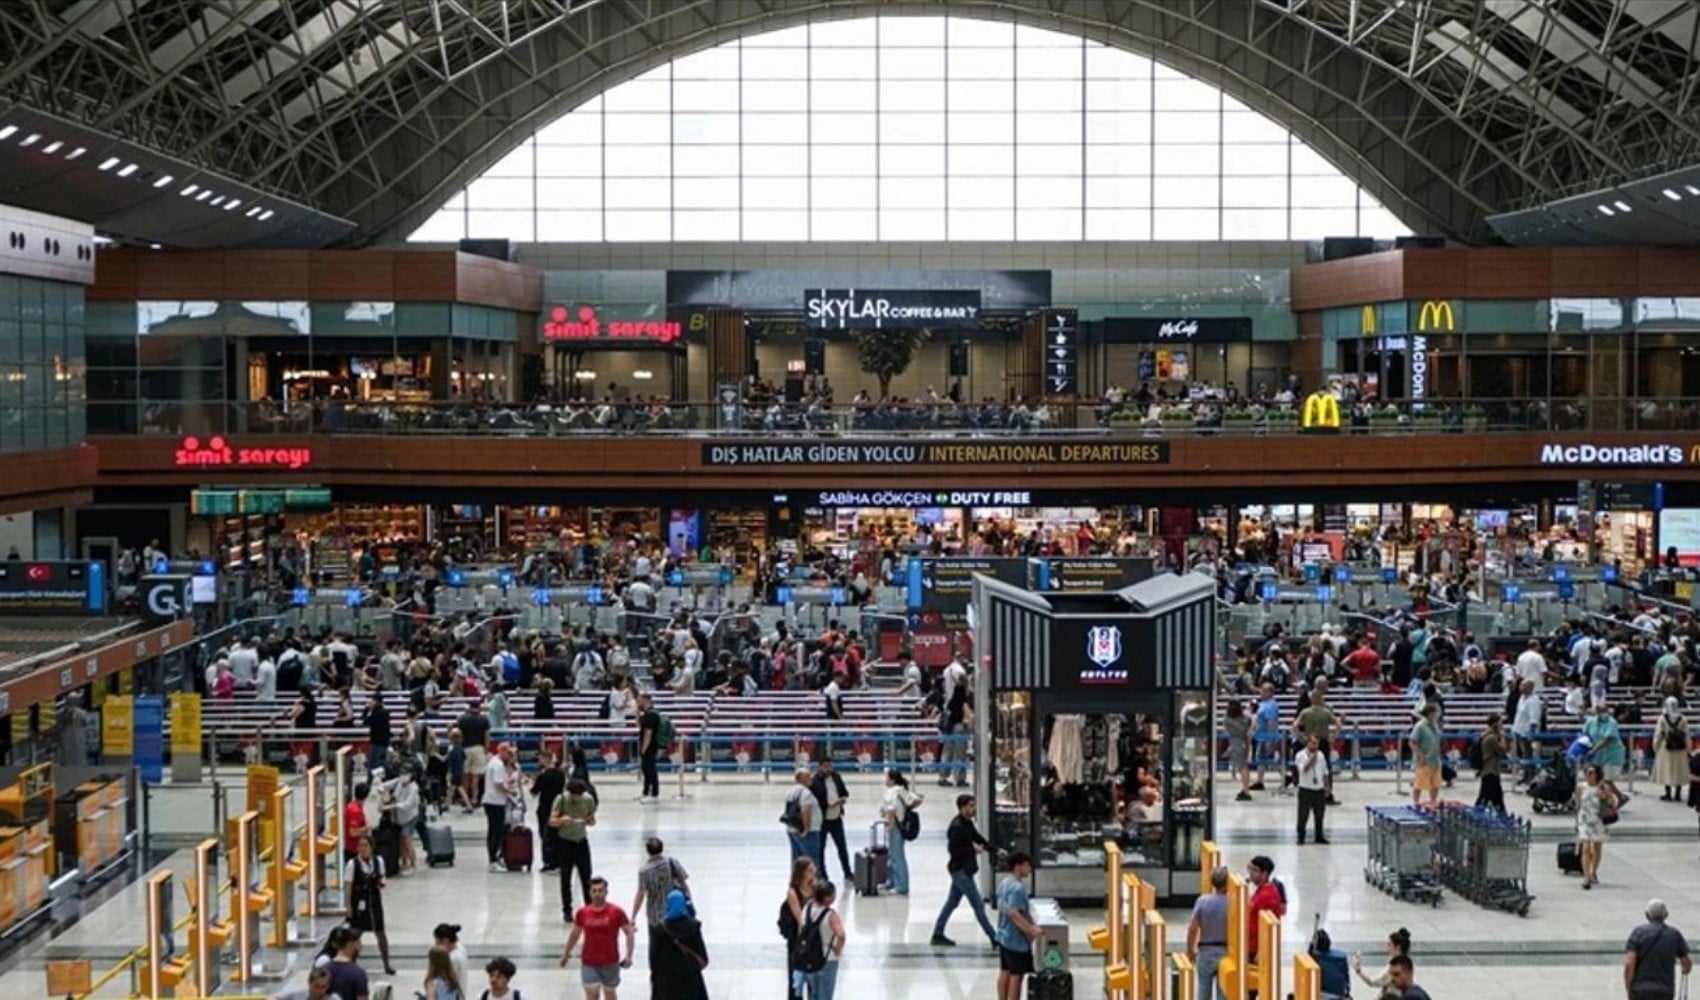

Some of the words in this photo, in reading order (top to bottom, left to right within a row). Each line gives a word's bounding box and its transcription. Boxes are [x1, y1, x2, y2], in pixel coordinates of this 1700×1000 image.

[543, 305, 599, 337] simit
[808, 291, 890, 325] SKYLAR
[890, 307, 932, 318] COFFEE
[175, 436, 232, 464] simit
[238, 449, 311, 468] sarayı
[711, 446, 738, 464] DIŞ
[743, 446, 804, 462] HATLAR
[808, 443, 858, 462] GİDEN
[862, 446, 914, 462] YOLCU
[929, 445, 1055, 461] INTERNATIONAL
[1060, 445, 1159, 462] DEPARTURES
[1541, 444, 1683, 463] McDonald's
[819, 490, 869, 504] SABİHA
[872, 490, 932, 507] GÖKÇEN
[951, 492, 991, 504] DUTY
[993, 492, 1030, 504] FREE
[148, 584, 175, 615] G
